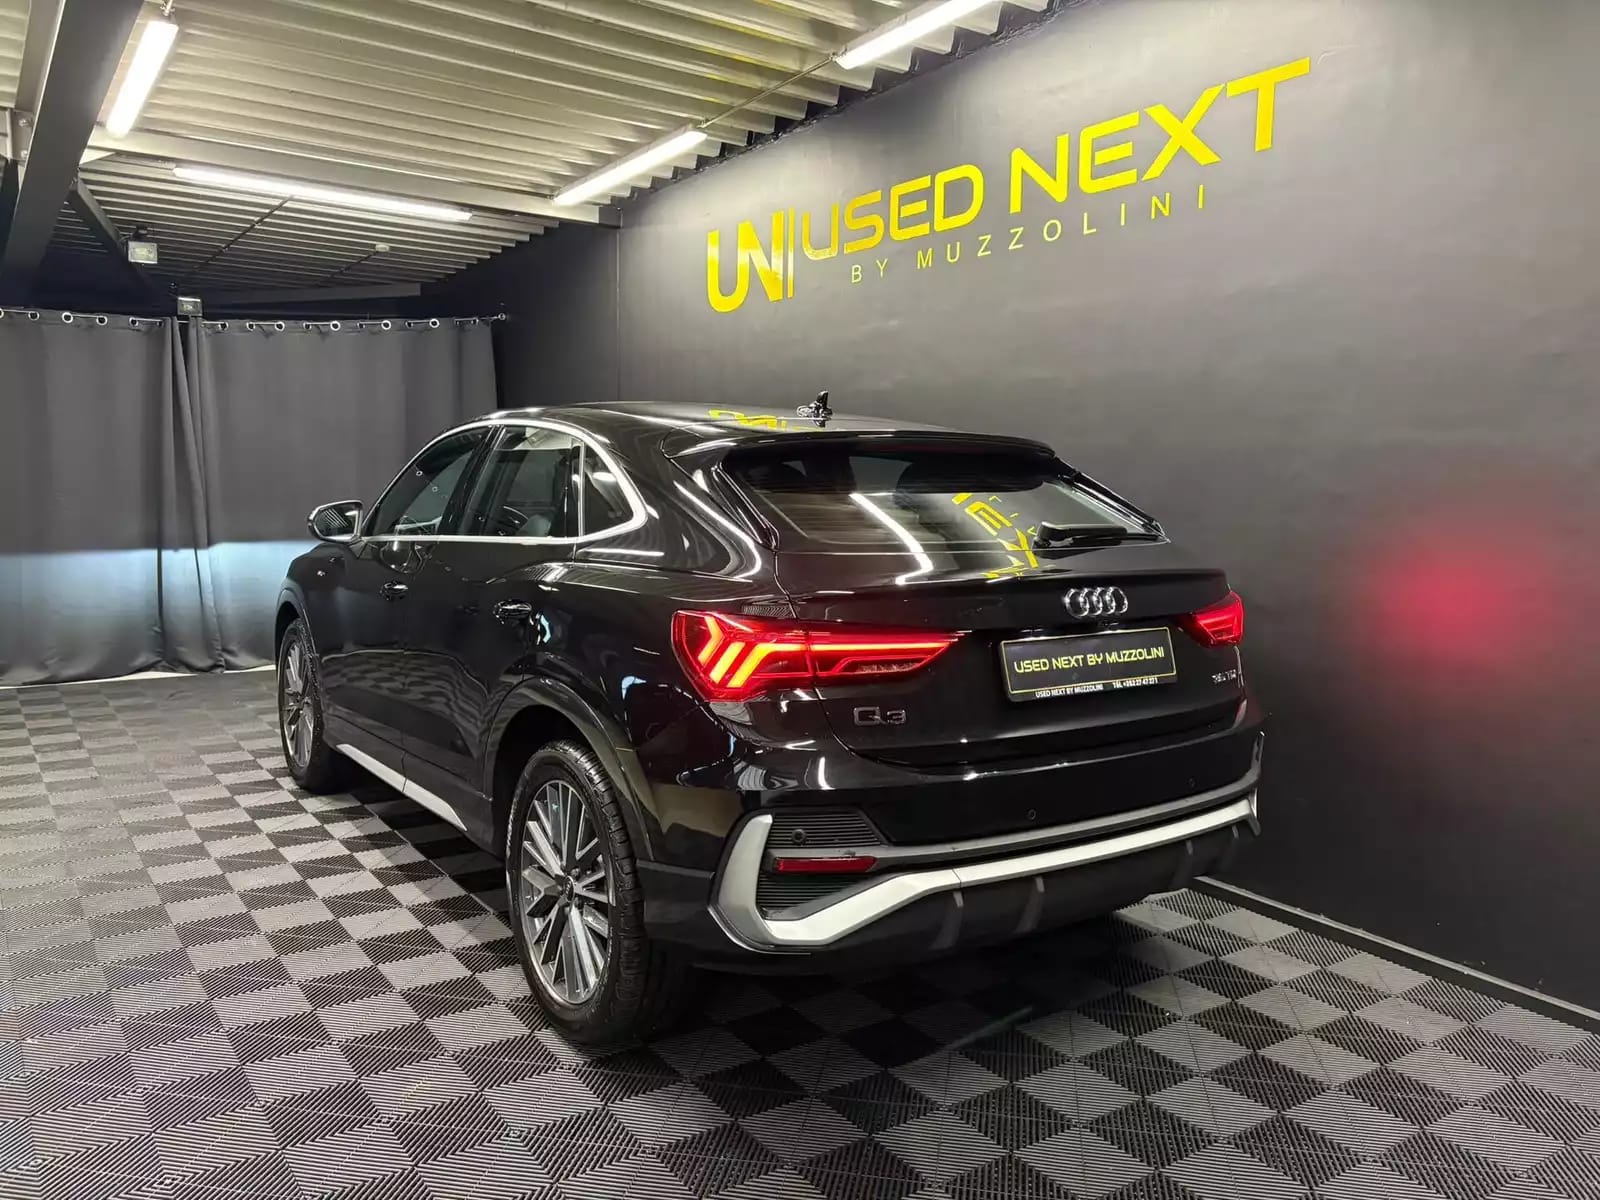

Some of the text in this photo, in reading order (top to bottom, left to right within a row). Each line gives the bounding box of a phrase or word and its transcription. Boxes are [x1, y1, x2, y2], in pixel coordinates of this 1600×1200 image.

[801, 58, 1311, 260] USED NEXT
[851, 184, 1204, 283] BY MUZZOLINI
[1014, 646, 1165, 673] USED NEXT BY MUZZOLINI
[1035, 690, 1051, 698] USED
[1051, 688, 1066, 696] NEXT
[1066, 686, 1074, 695] BY
[853, 706, 907, 726] Q3
